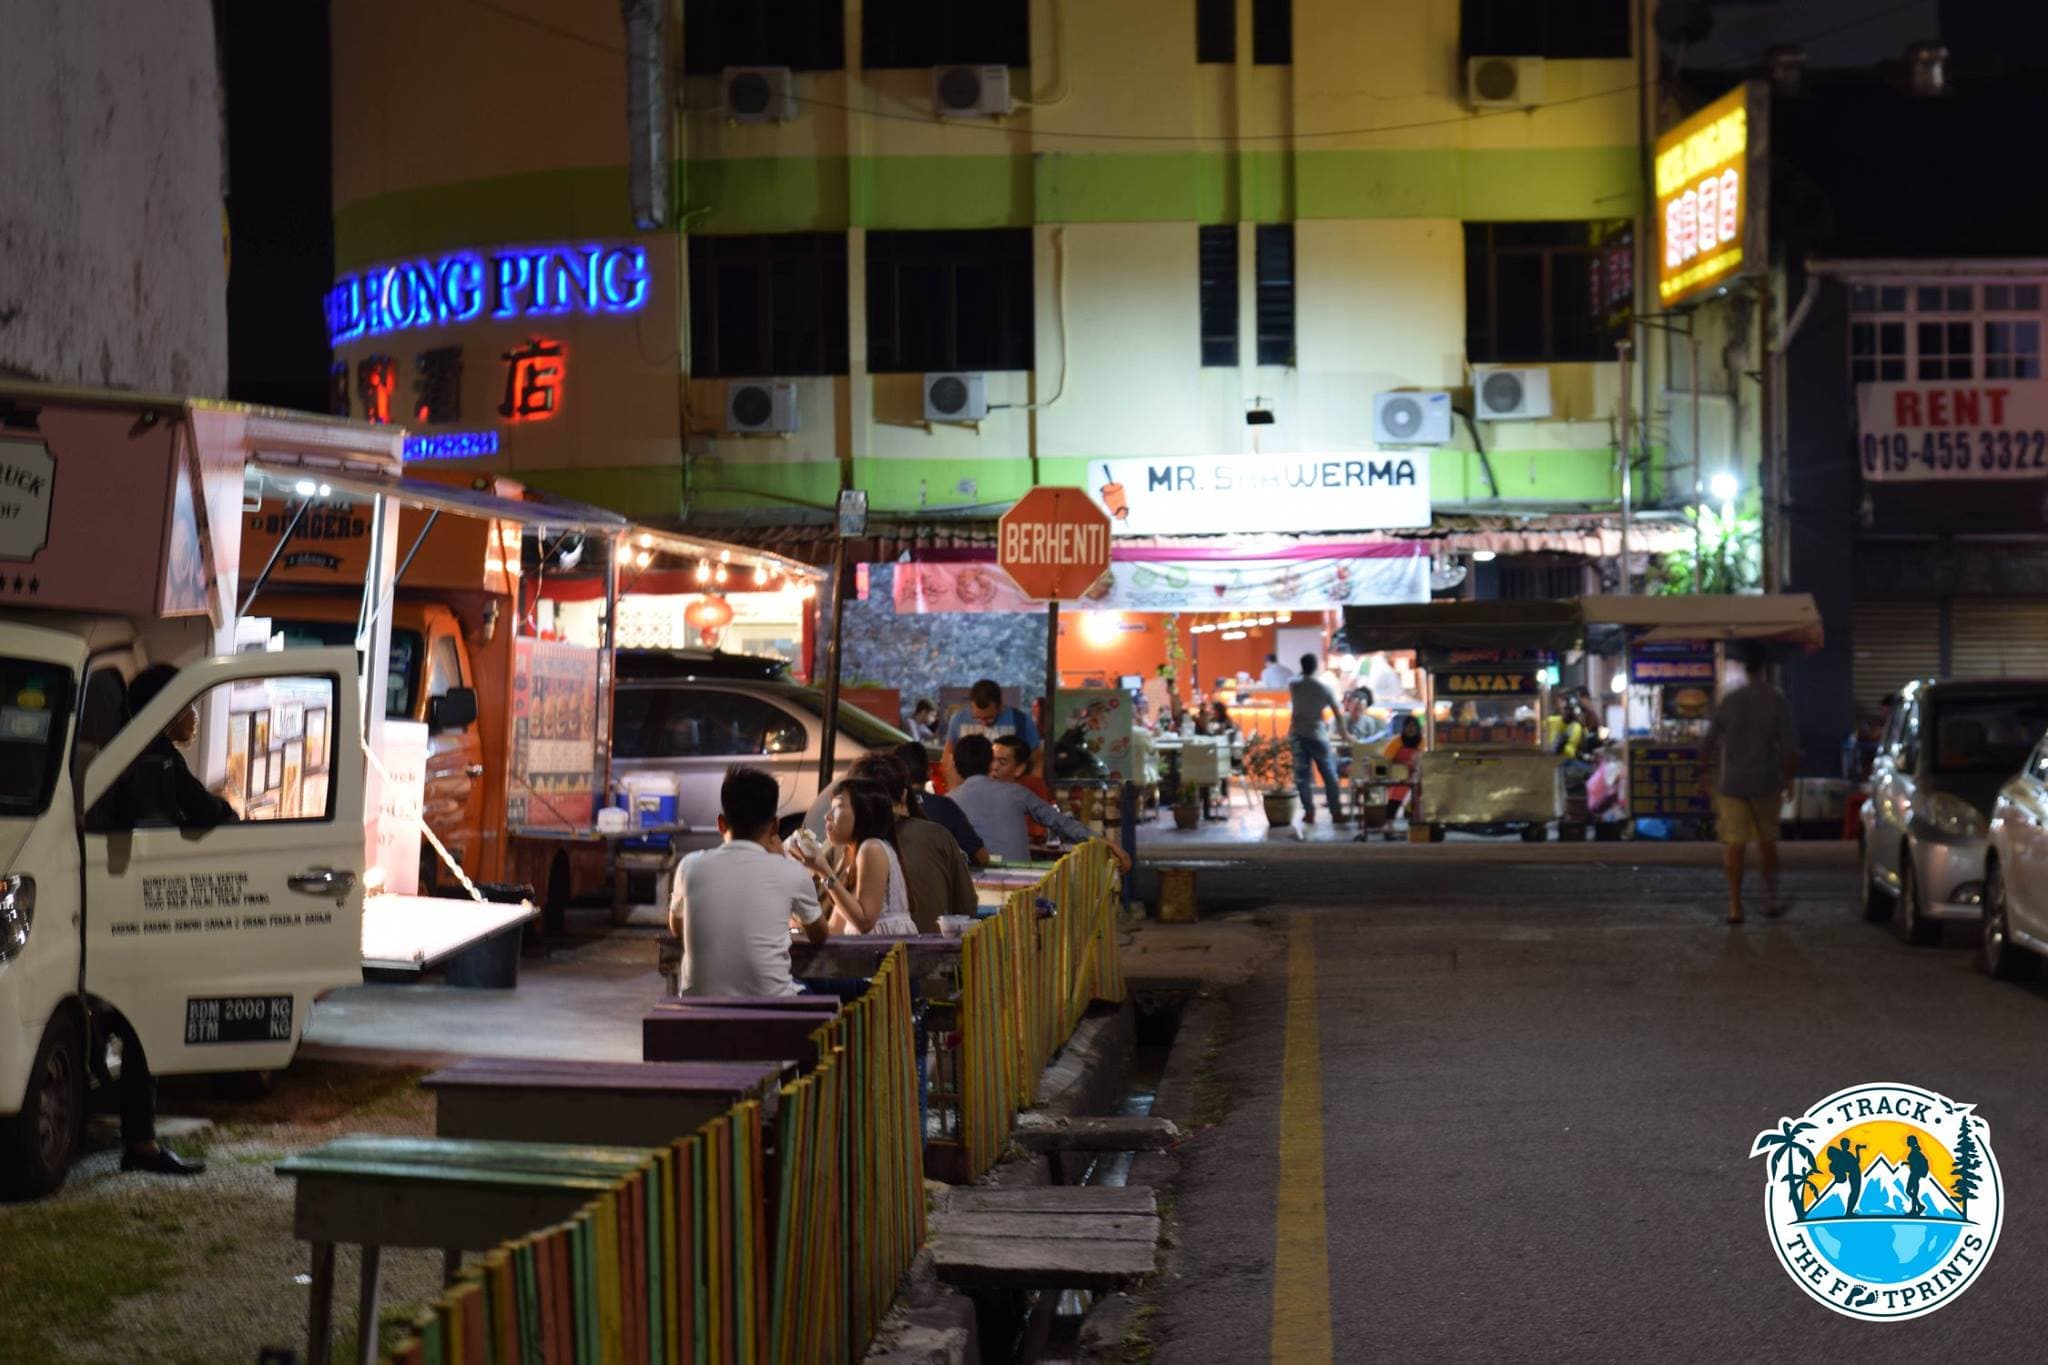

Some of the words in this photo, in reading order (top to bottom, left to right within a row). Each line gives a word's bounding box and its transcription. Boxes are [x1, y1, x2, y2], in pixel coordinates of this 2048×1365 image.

[491, 246, 650, 318] PING
[1894, 388, 2010, 428] RENT
[1863, 431, 1971, 472] 019-455
[1979, 429, 2046, 470] 3322
[1148, 466, 1204, 492] MR.
[1004, 523, 1105, 565] BERHENTI
[190, 1001, 220, 1020] BDM
[225, 1000, 266, 1020] 2000
[271, 998, 290, 1017] KG
[188, 1021, 218, 1041] BTM
[270, 1018, 290, 1038] KG
